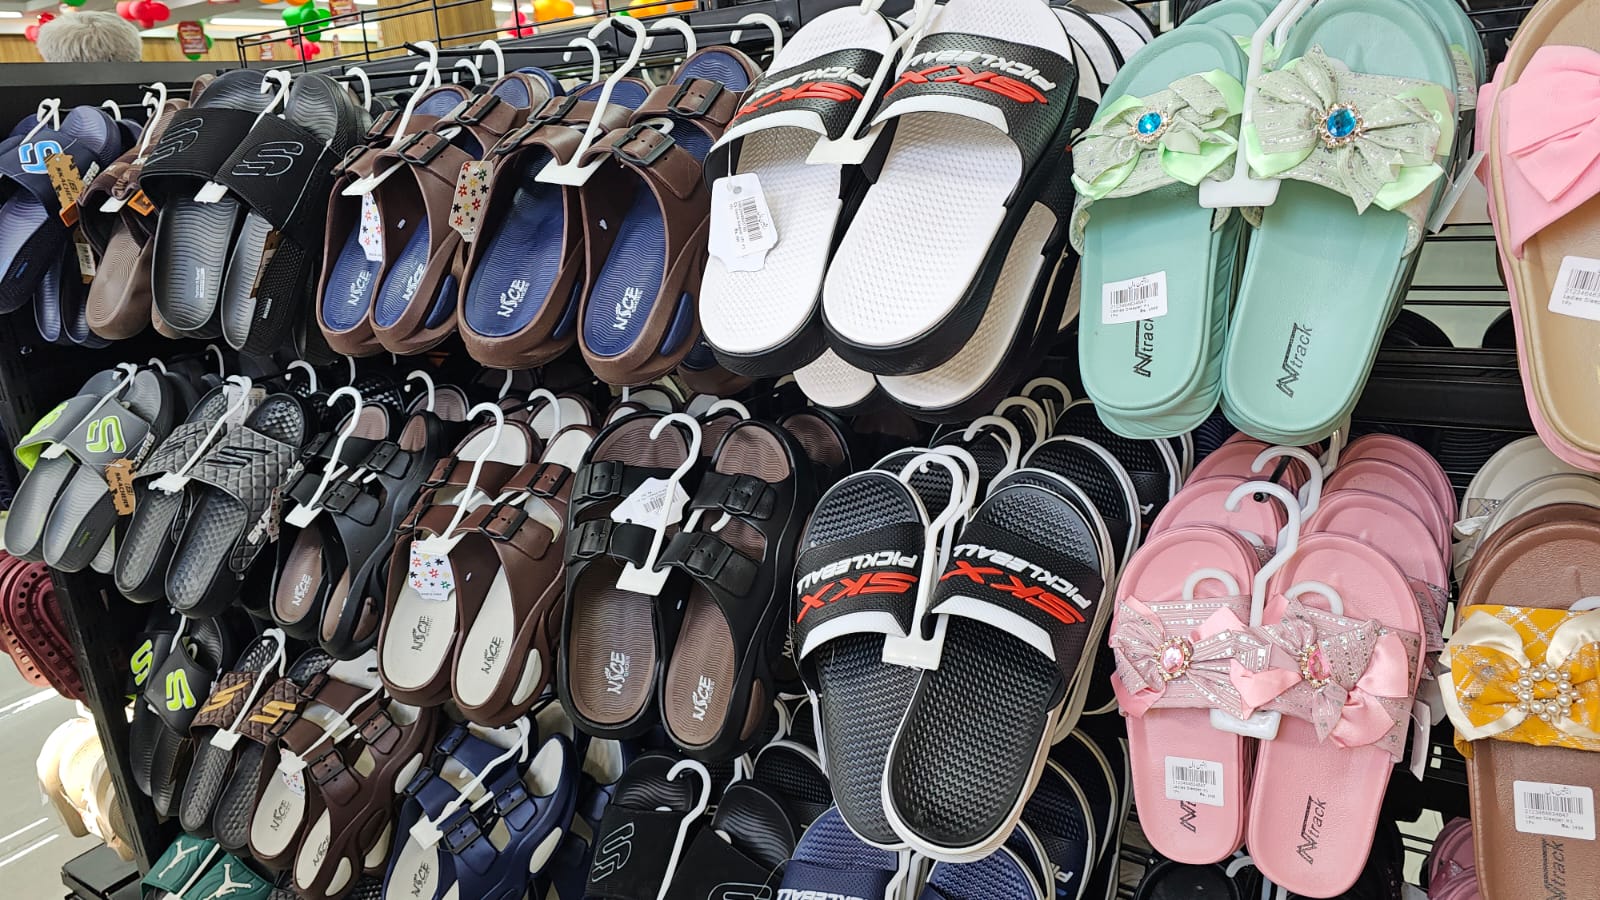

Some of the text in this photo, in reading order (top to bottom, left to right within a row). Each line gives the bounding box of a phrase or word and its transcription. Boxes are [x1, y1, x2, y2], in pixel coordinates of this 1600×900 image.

[910, 50, 1057, 92] PICKLEBAL
[796, 551, 919, 595] PICKLEBALL
[796, 572, 919, 624] SKX
[940, 560, 1087, 624] SKX
[953, 543, 1092, 610] PICKLEBALL
